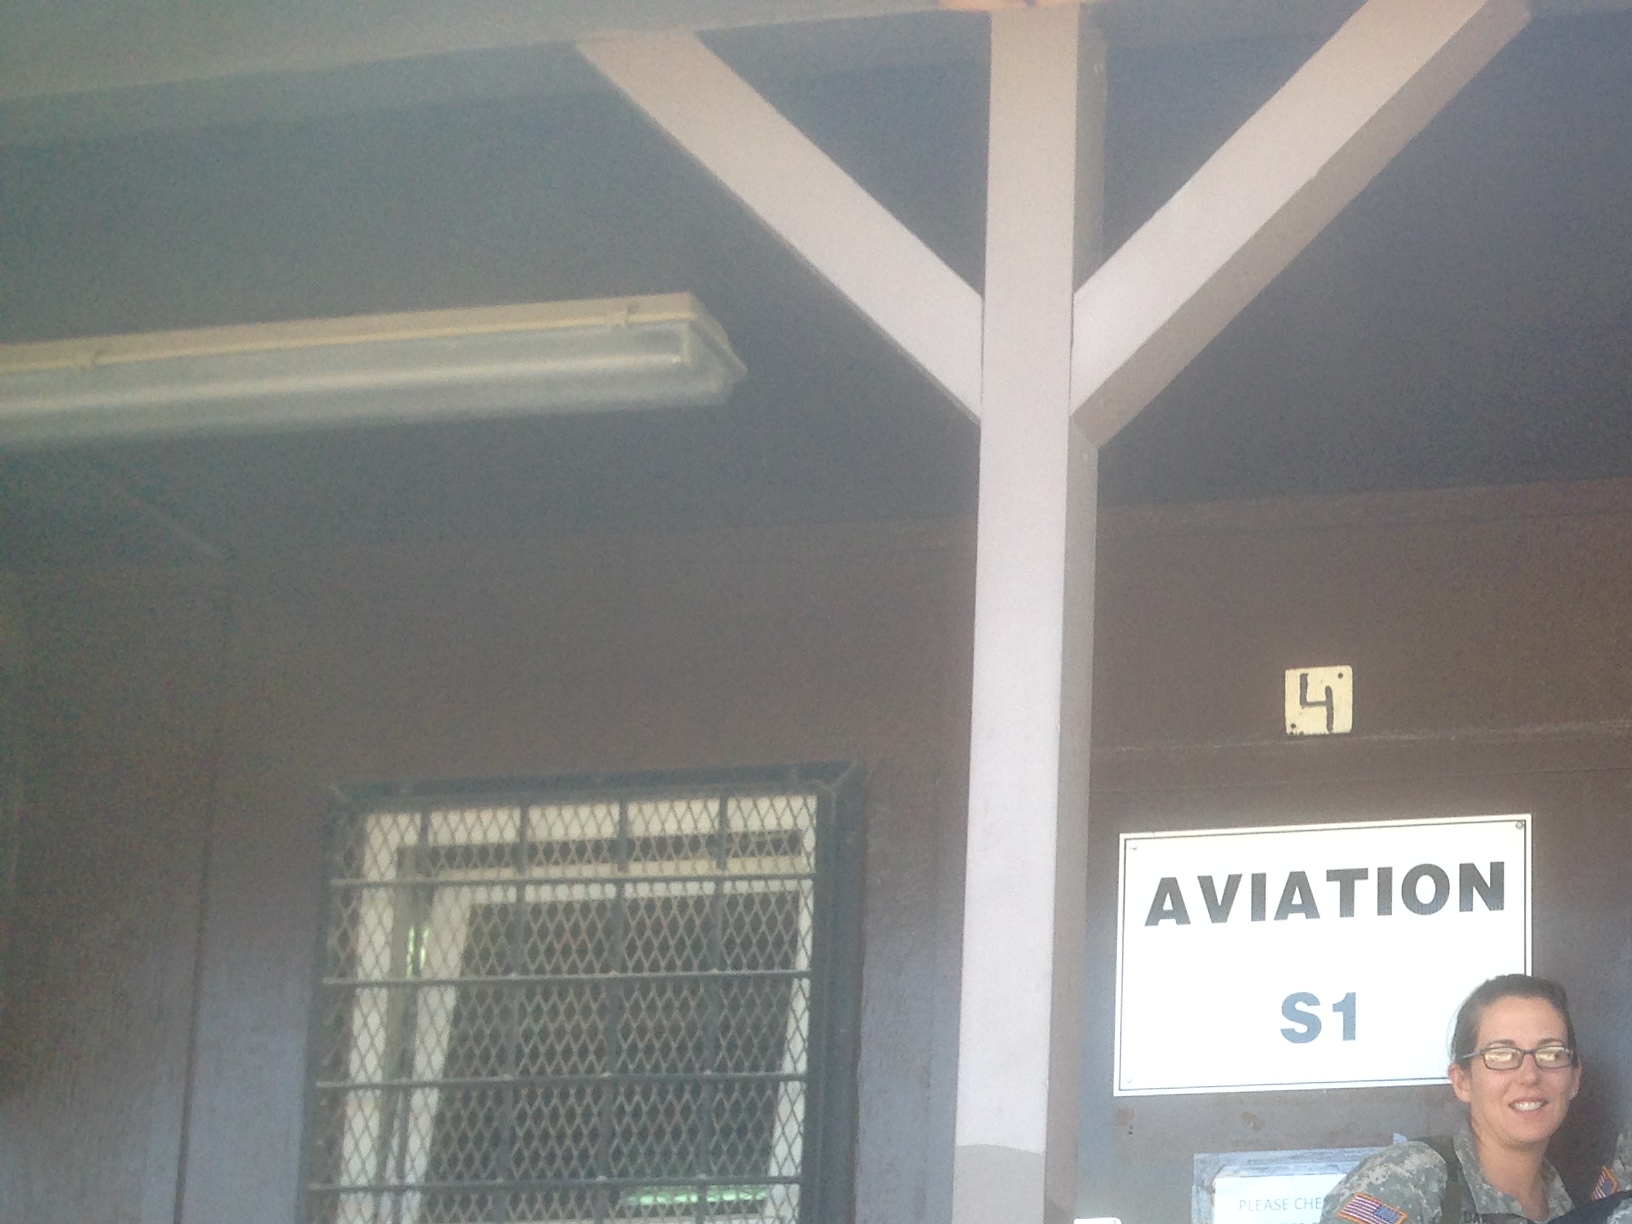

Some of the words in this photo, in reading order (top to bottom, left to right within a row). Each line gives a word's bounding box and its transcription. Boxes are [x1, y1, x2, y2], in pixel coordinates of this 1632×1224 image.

[1300, 672, 1334, 733] 4
[1144, 860, 1505, 927] AVIATION
[1280, 991, 1357, 1044] S1
[1238, 1198, 1290, 1212] PLEASE
